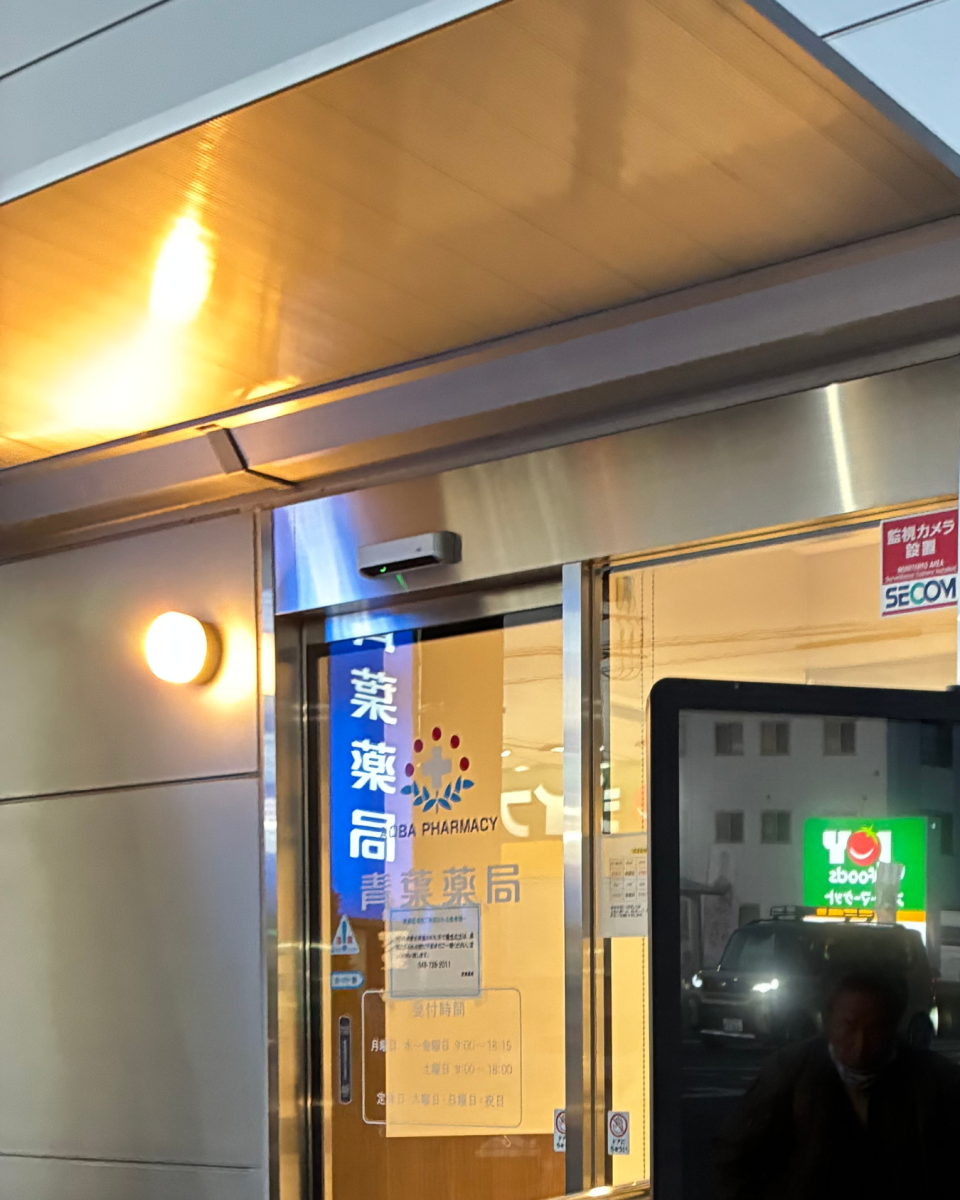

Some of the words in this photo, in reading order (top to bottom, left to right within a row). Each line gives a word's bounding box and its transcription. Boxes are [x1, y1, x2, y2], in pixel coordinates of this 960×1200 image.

[886, 519, 955, 546] 監視カメラ
[905, 539, 936, 560] 設置
[885, 577, 957, 609] SECOM
[422, 816, 499, 837] PHARMACY
[361, 863, 521, 912] 青葉薬局
[412, 1001, 466, 1018] 受付時間
